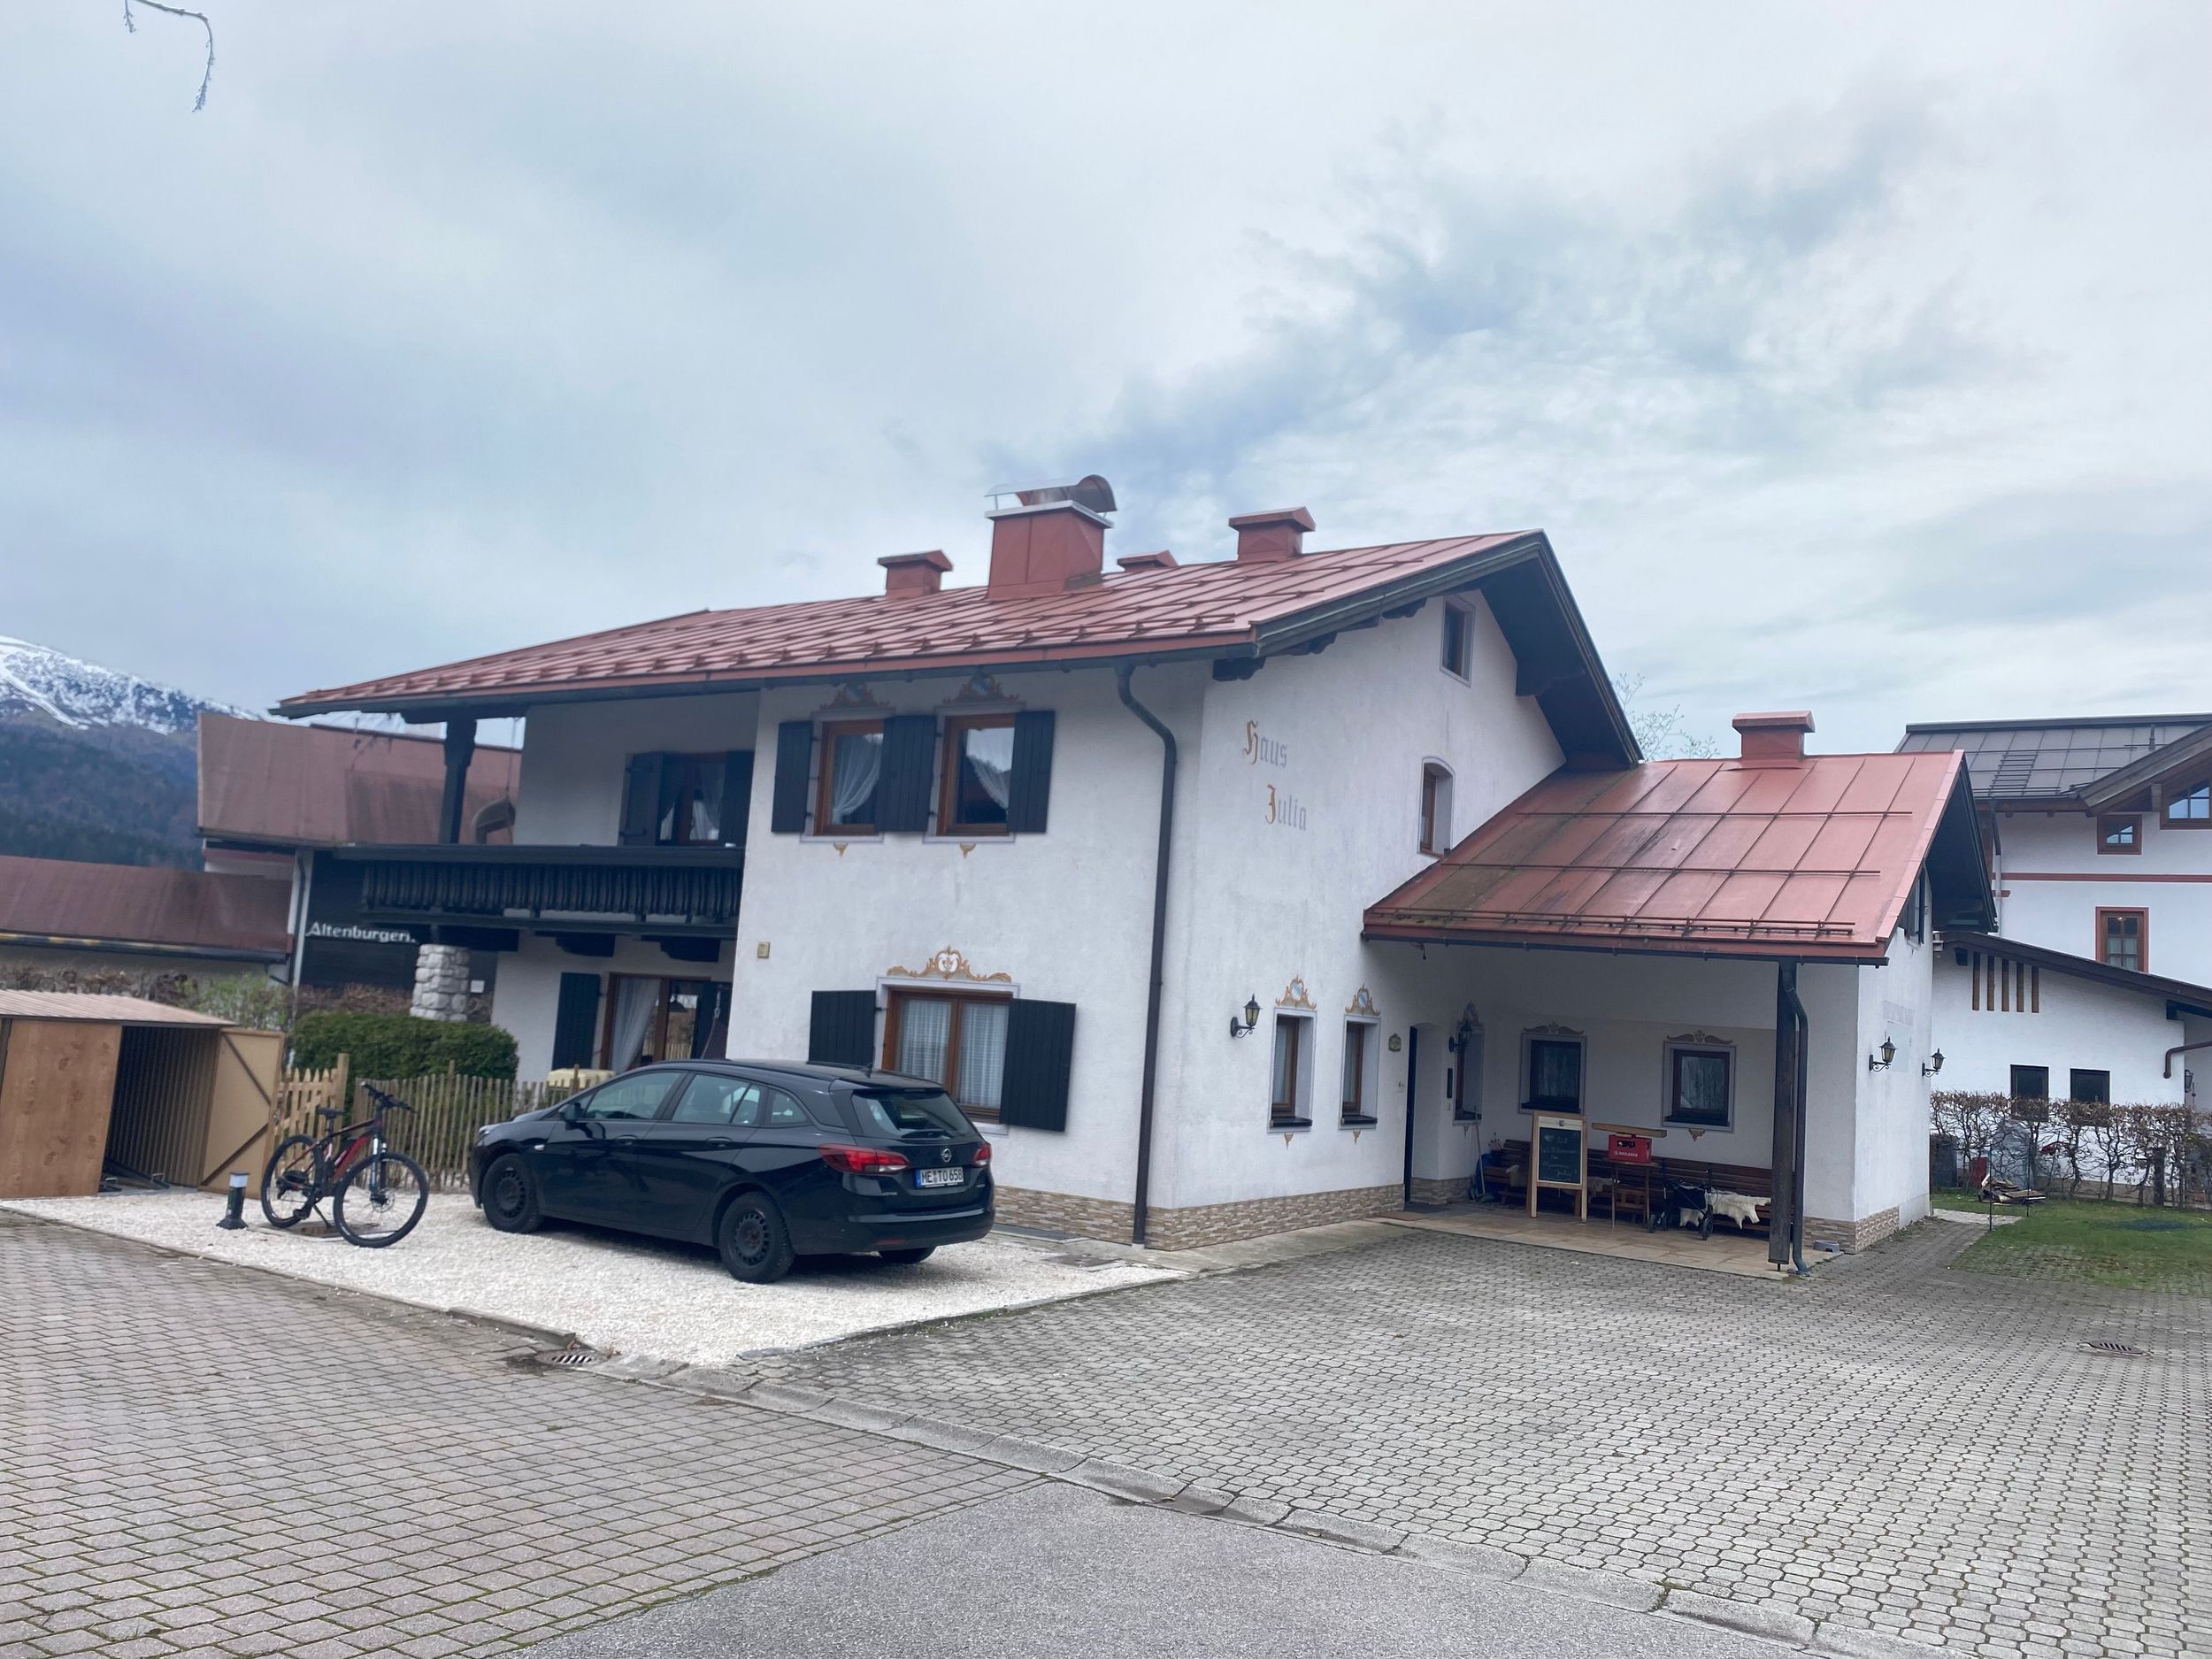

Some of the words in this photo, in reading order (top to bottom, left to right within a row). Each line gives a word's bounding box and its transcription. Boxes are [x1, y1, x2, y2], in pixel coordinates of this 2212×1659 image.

[1242, 720, 1287, 768] Haus
[1265, 784, 1307, 831] Julia
[921, 1170, 933, 1184] ME
